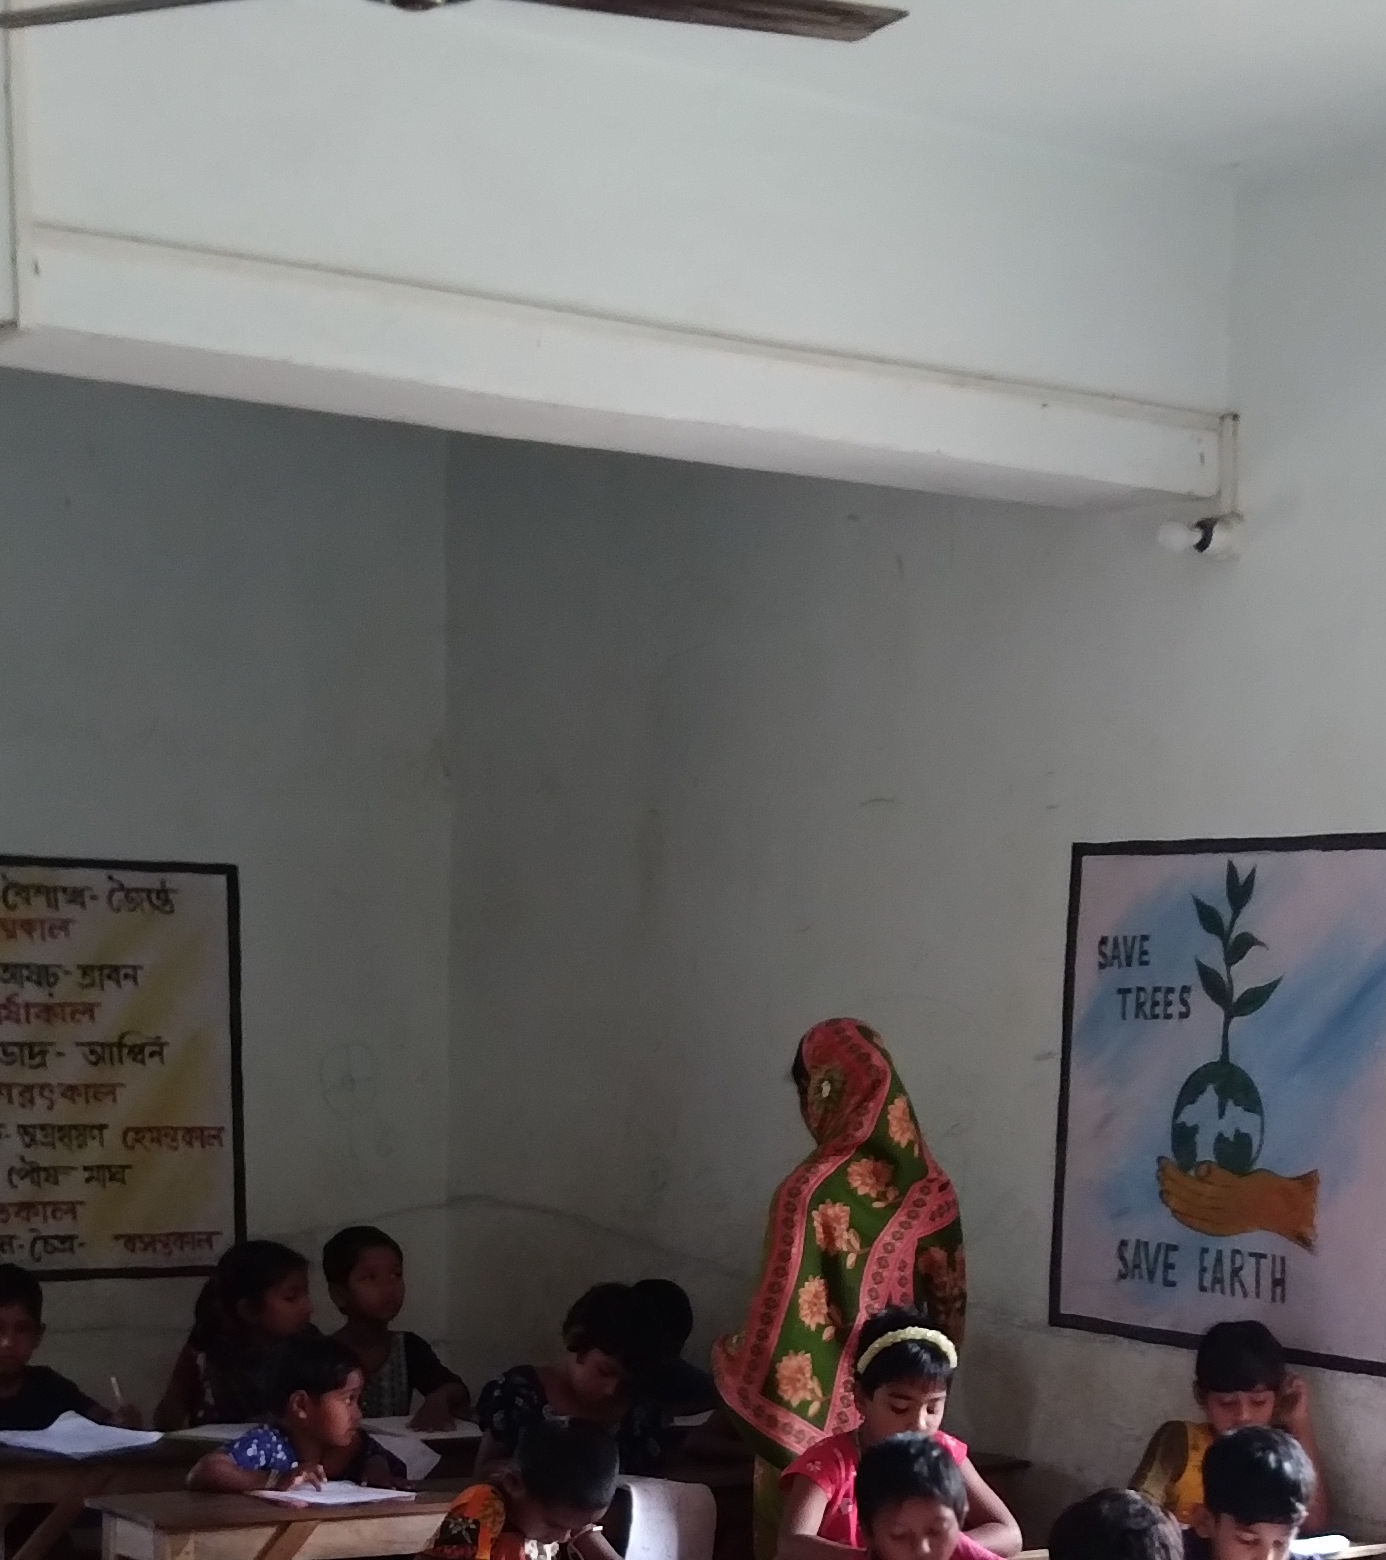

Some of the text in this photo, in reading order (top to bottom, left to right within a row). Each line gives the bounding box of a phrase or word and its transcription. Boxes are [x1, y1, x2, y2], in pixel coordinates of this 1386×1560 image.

[1097, 934, 1151, 971] SAVE
[1116, 985, 1192, 1021] TREES
[1116, 1238, 1287, 1304] SAVE EARTH
